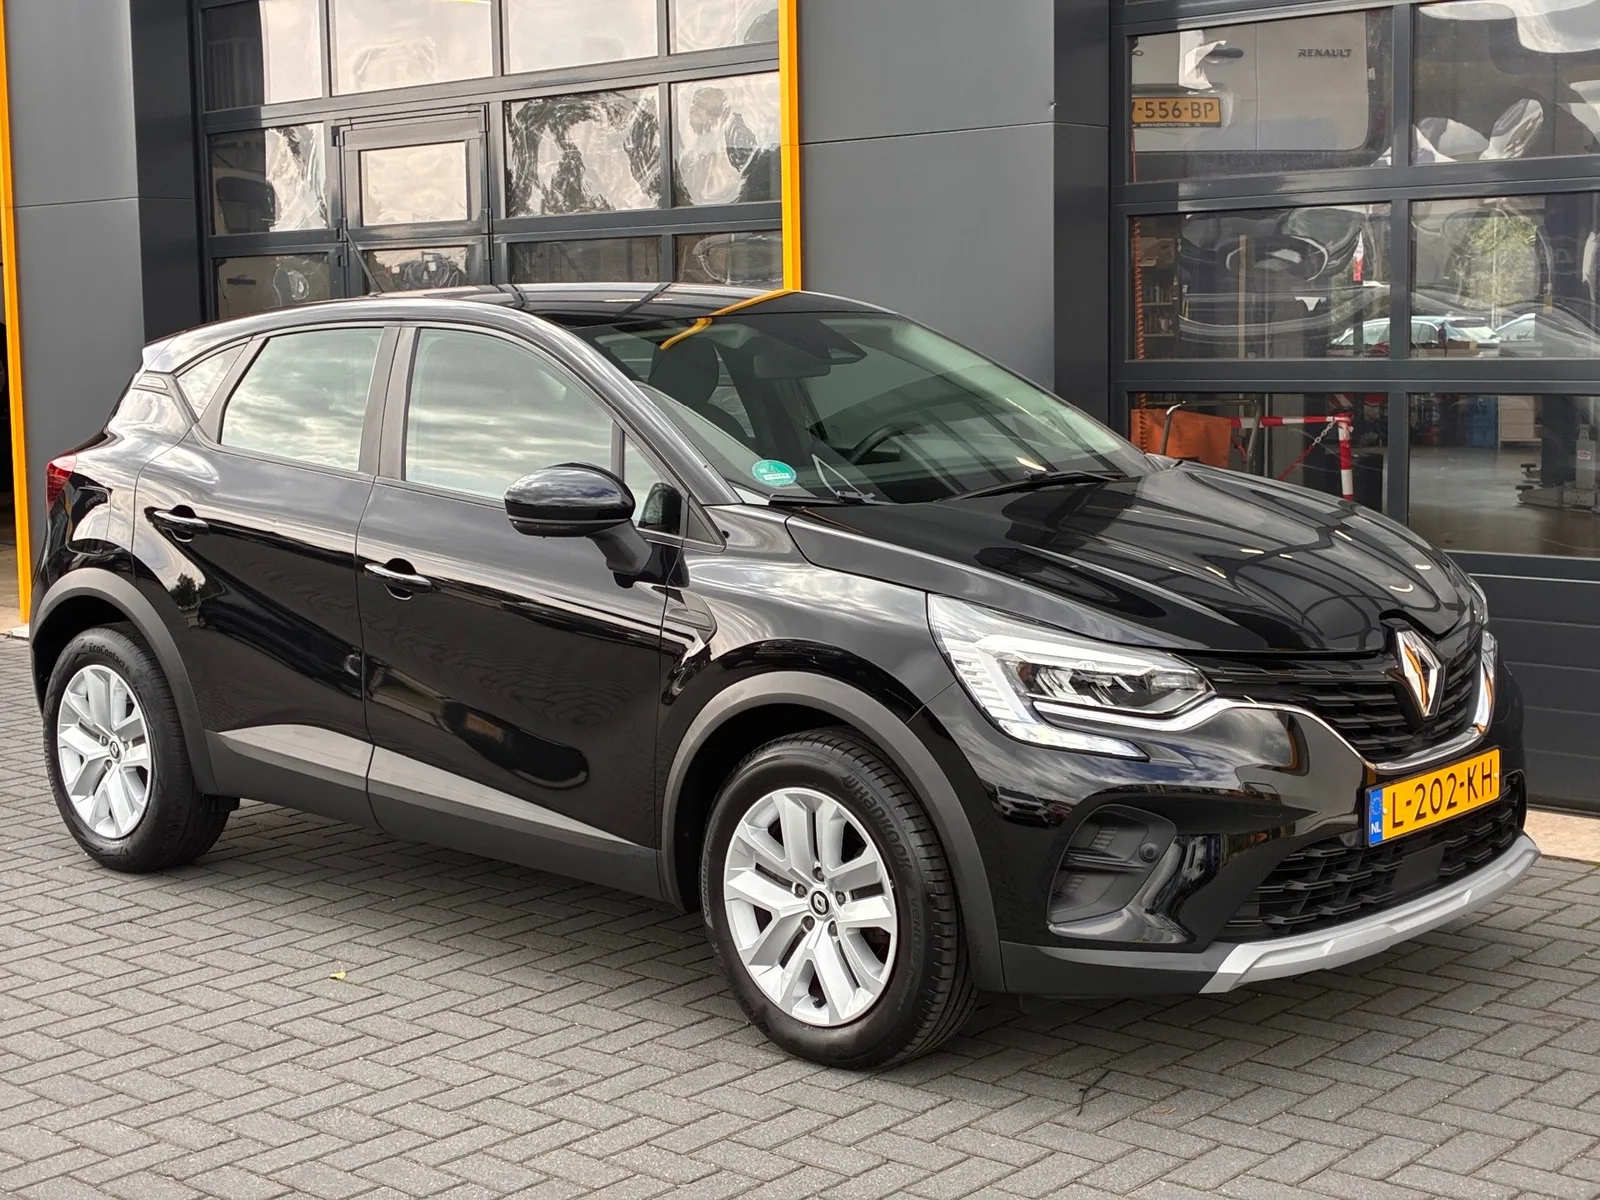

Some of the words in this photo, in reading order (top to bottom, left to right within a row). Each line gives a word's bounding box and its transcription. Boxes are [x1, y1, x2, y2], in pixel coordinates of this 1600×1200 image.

[1297, 48, 1352, 58] RENAULT
[1391, 758, 1494, 830] L-202-KH
[1371, 821, 1382, 836] NL
